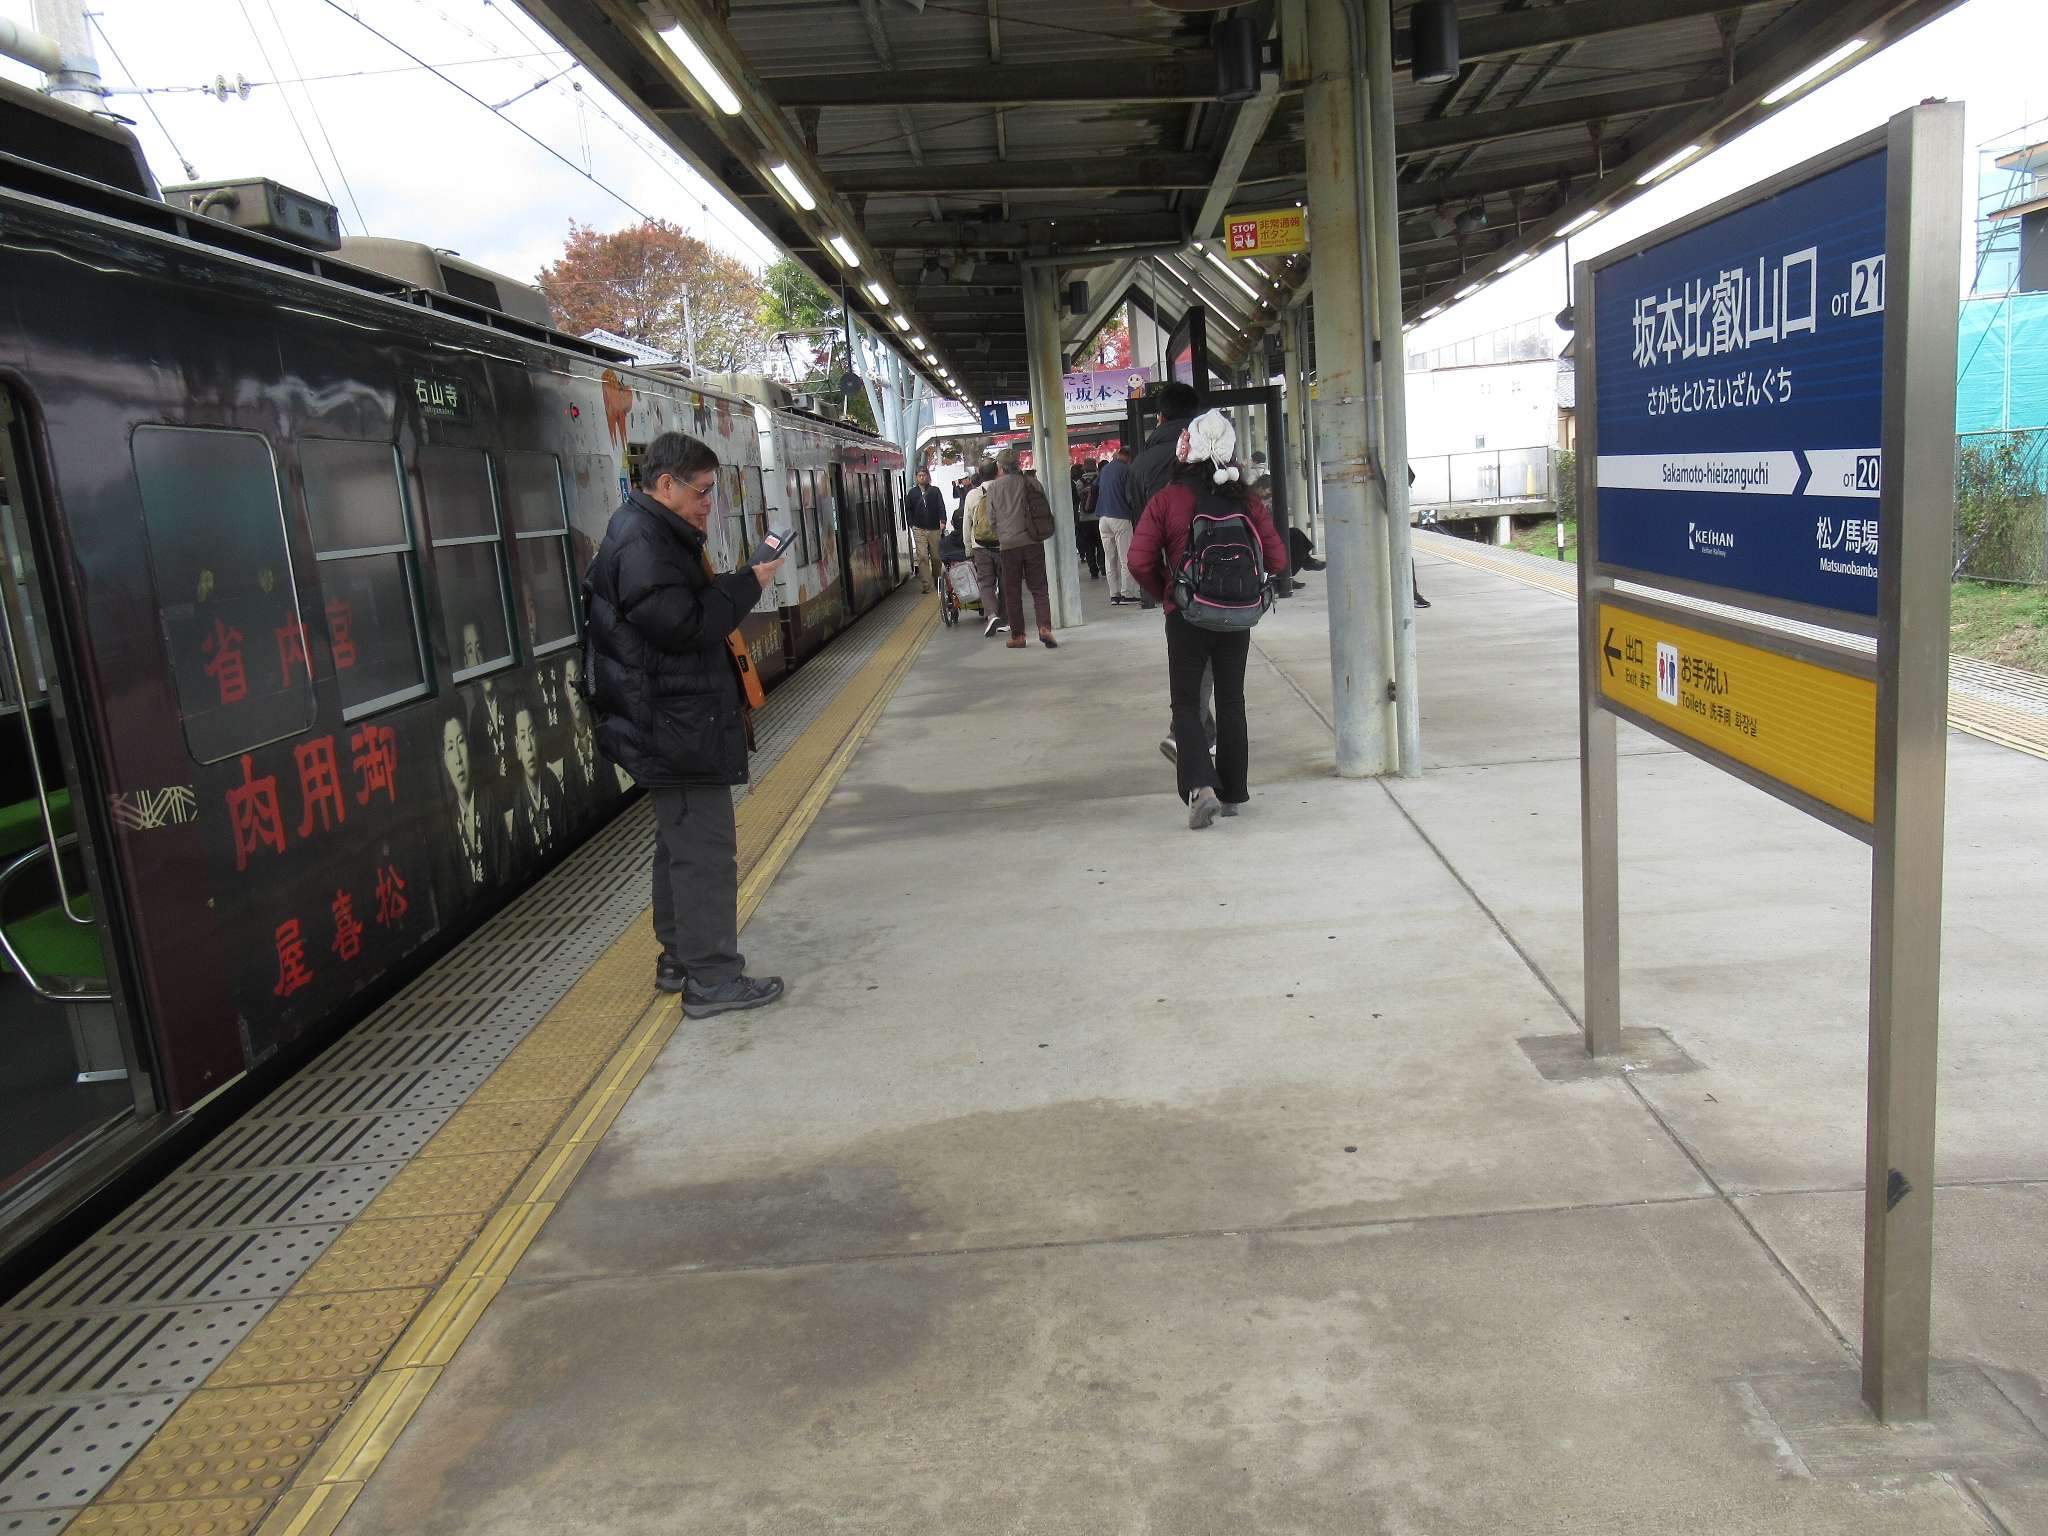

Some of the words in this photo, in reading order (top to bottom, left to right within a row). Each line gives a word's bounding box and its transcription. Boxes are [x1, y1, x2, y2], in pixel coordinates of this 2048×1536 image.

[1231, 223, 1256, 234] STOP
[1260, 229, 1289, 240] ボタン
[1832, 294, 1849, 317] OT
[1854, 259, 1884, 314] 21
[1632, 246, 1817, 368] 坂本比叡山口
[414, 378, 457, 408] 石山寺
[1648, 366, 1792, 415] さかもとひえいざんぐち
[990, 409, 998, 425] 1
[1662, 461, 1769, 491] Sakamoto-hieizanguchi
[1843, 473, 1855, 488] OT
[1857, 457, 1879, 489] 20
[1695, 529, 1734, 548] KEIHAN
[1816, 516, 1879, 555] 松ノ馬場
[1819, 557, 1878, 578] Matsunobamba
[1625, 635, 1643, 664] 出口
[1625, 668, 1638, 687] Exit
[1681, 655, 1729, 695] お手洗い
[1681, 690, 1707, 716] Toilets
[1735, 711, 1757, 737] 화장실
